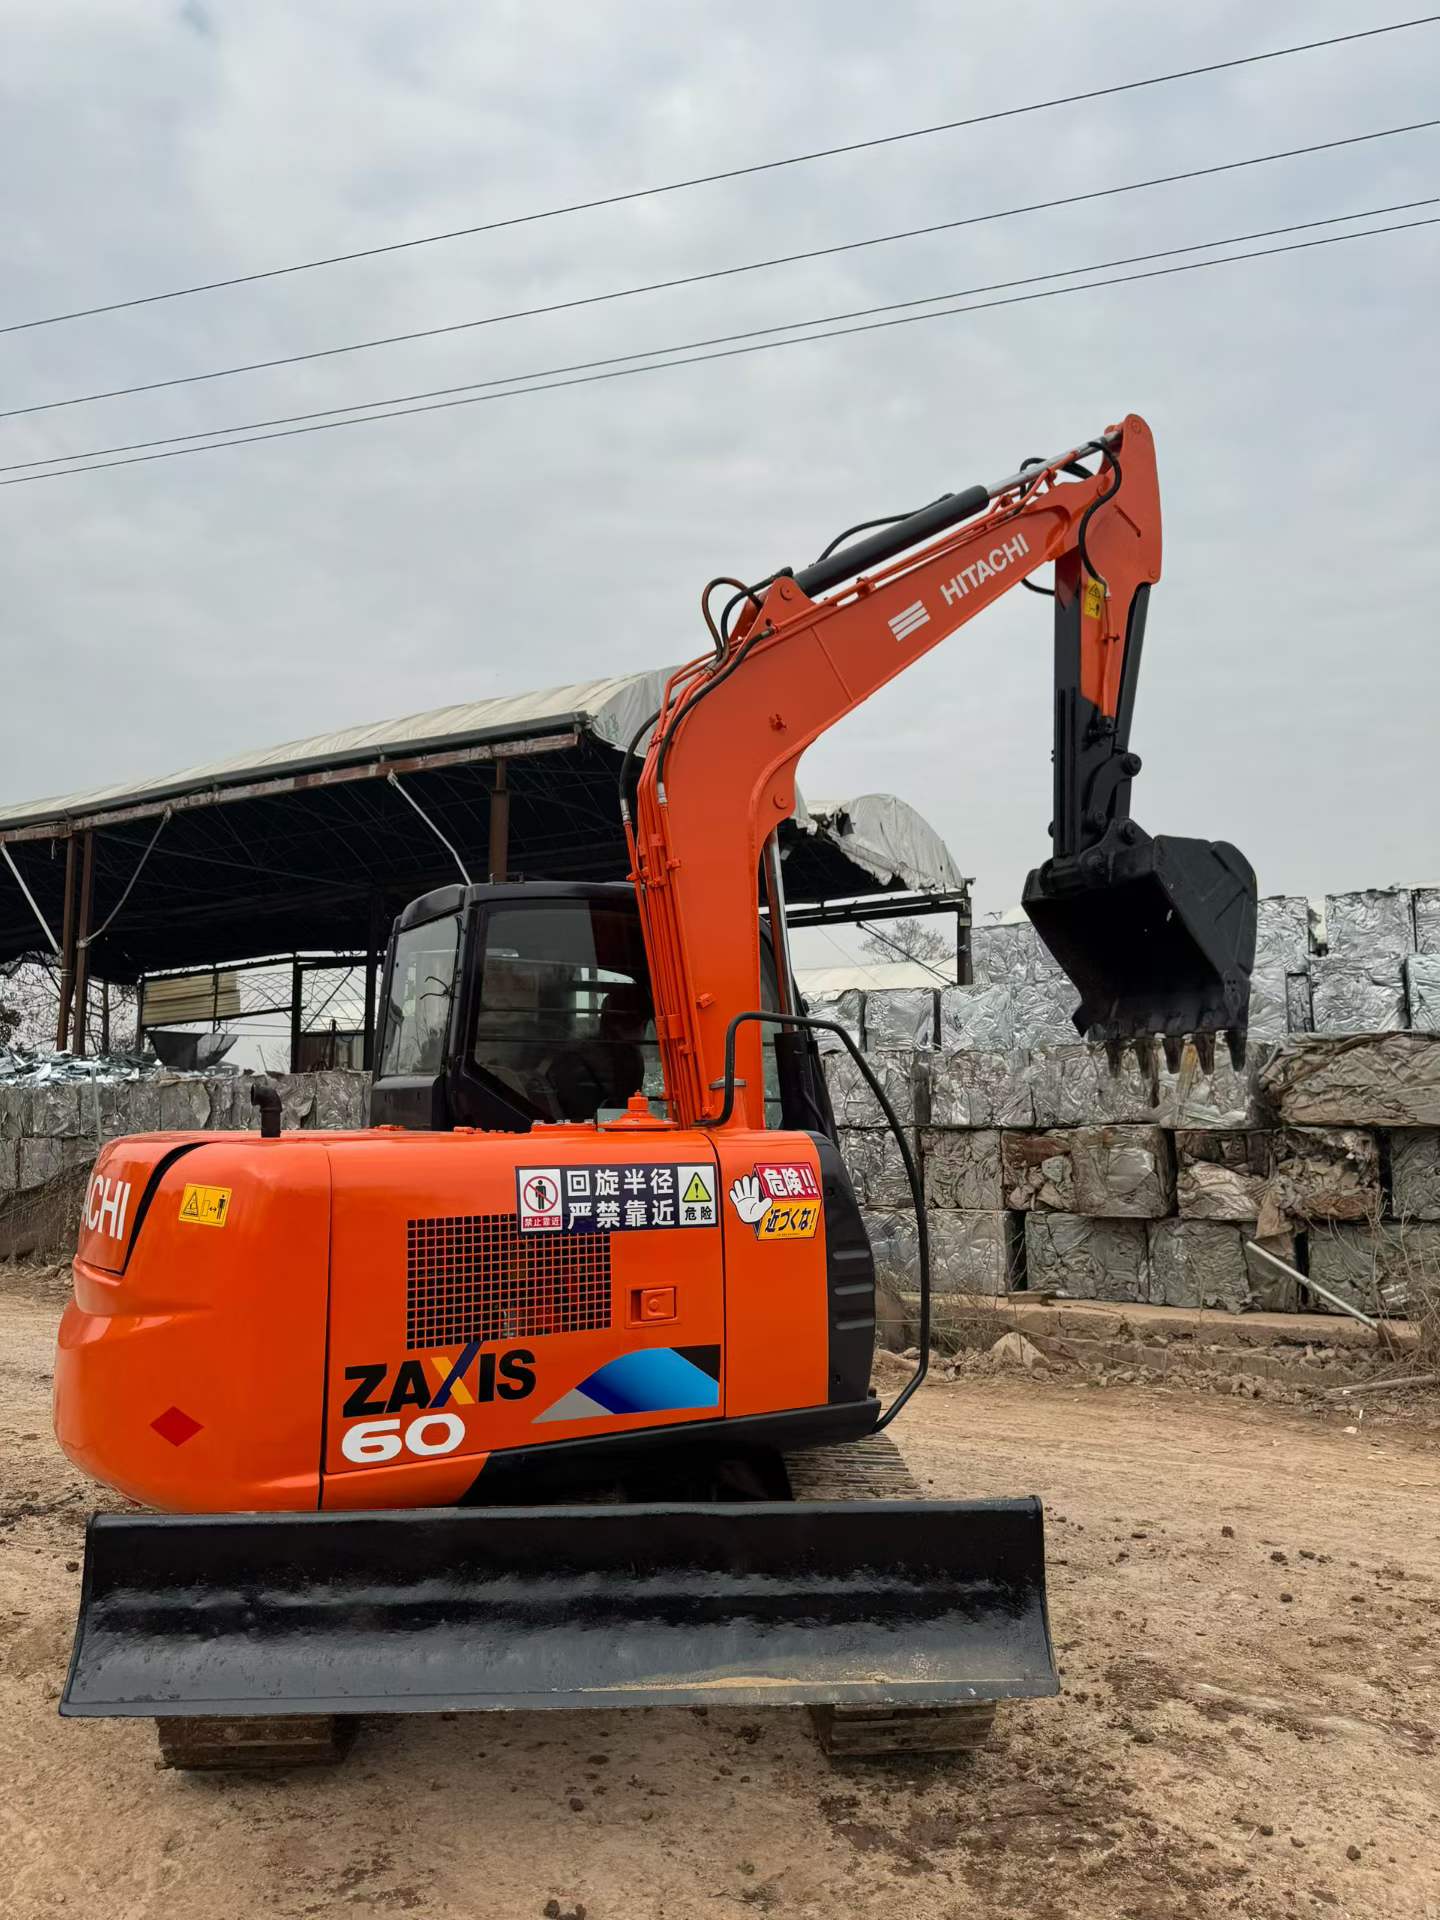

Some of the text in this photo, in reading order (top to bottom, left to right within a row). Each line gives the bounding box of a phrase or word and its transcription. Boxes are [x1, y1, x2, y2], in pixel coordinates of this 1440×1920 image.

[940, 533, 1030, 606] HITACHI
[566, 1168, 675, 1197] 回旋半径
[523, 1216, 561, 1228] 禁止靠近
[567, 1199, 675, 1230] 严禁靠近
[684, 1205, 713, 1221] 危险
[342, 1341, 537, 1418] ZAXIS
[341, 1412, 466, 1464] 60
